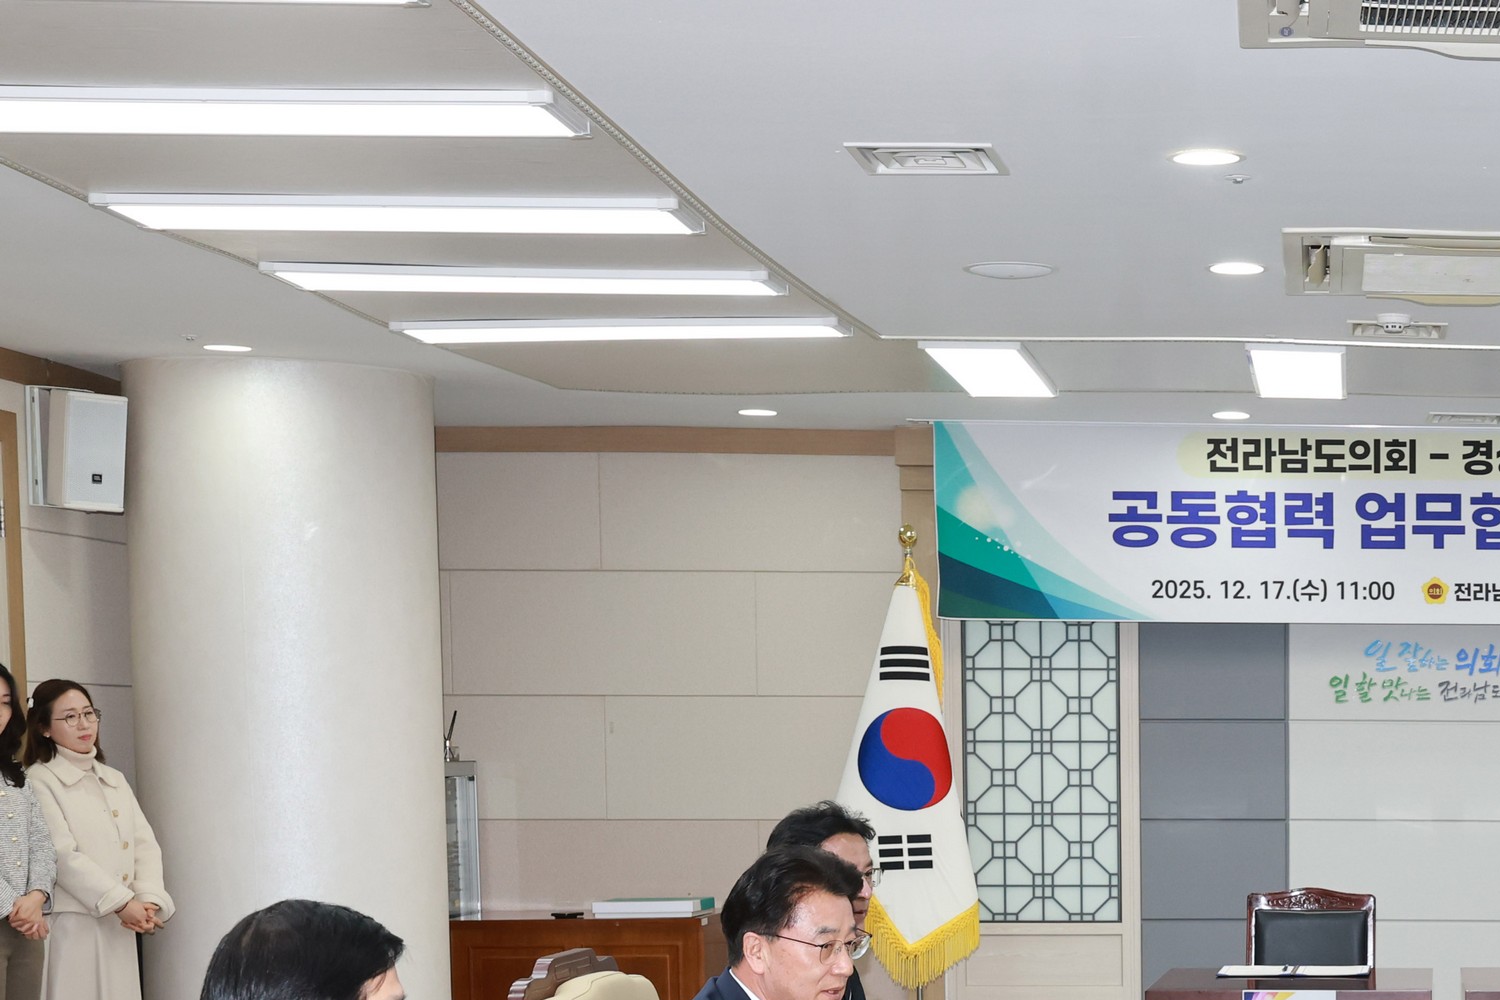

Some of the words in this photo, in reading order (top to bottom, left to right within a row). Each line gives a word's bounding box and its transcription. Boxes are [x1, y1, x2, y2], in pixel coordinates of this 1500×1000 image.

[1206, 437, 1417, 474] 전라남도의회
[1108, 490, 1335, 550] 공동협력
[1151, 579, 1211, 600] 2025.
[1219, 580, 1251, 600] 12.
[1259, 578, 1328, 602] 17.(수)
[1336, 580, 1395, 601] 11:00
